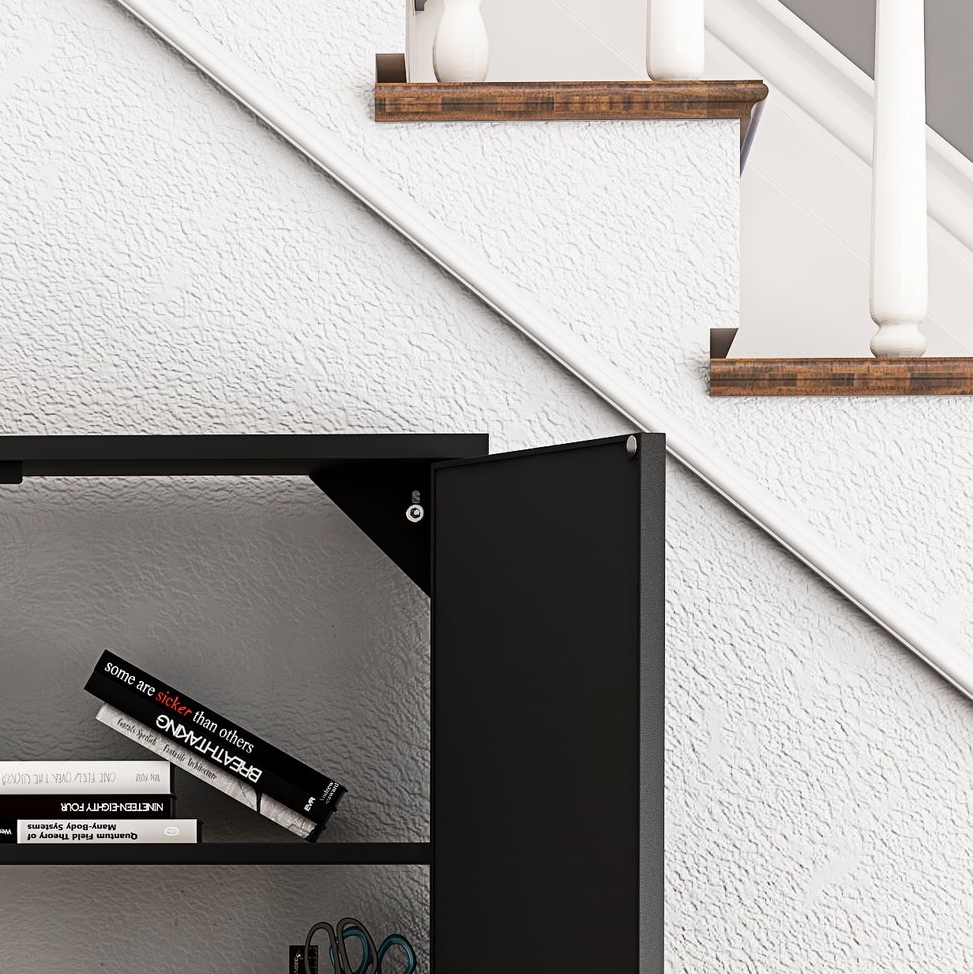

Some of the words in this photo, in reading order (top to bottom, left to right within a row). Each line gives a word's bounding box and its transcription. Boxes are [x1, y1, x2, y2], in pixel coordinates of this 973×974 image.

[104, 662, 136, 685] some
[136, 680, 156, 696] are
[156, 690, 192, 717] sicker
[192, 710, 218, 732] than
[218, 730, 254, 754] others
[156, 714, 263, 784] BREATHTAKING
[60, 802, 84, 812] FOUR
[86, 802, 164, 812] NINETEEN-EIGHTY
[27, 822, 64, 831] Systems
[66, 822, 117, 831] Many-Body
[27, 832, 36, 840] of
[38, 831, 69, 840] Theory
[72, 832, 94, 840] Field
[96, 832, 138, 840] Quantum
